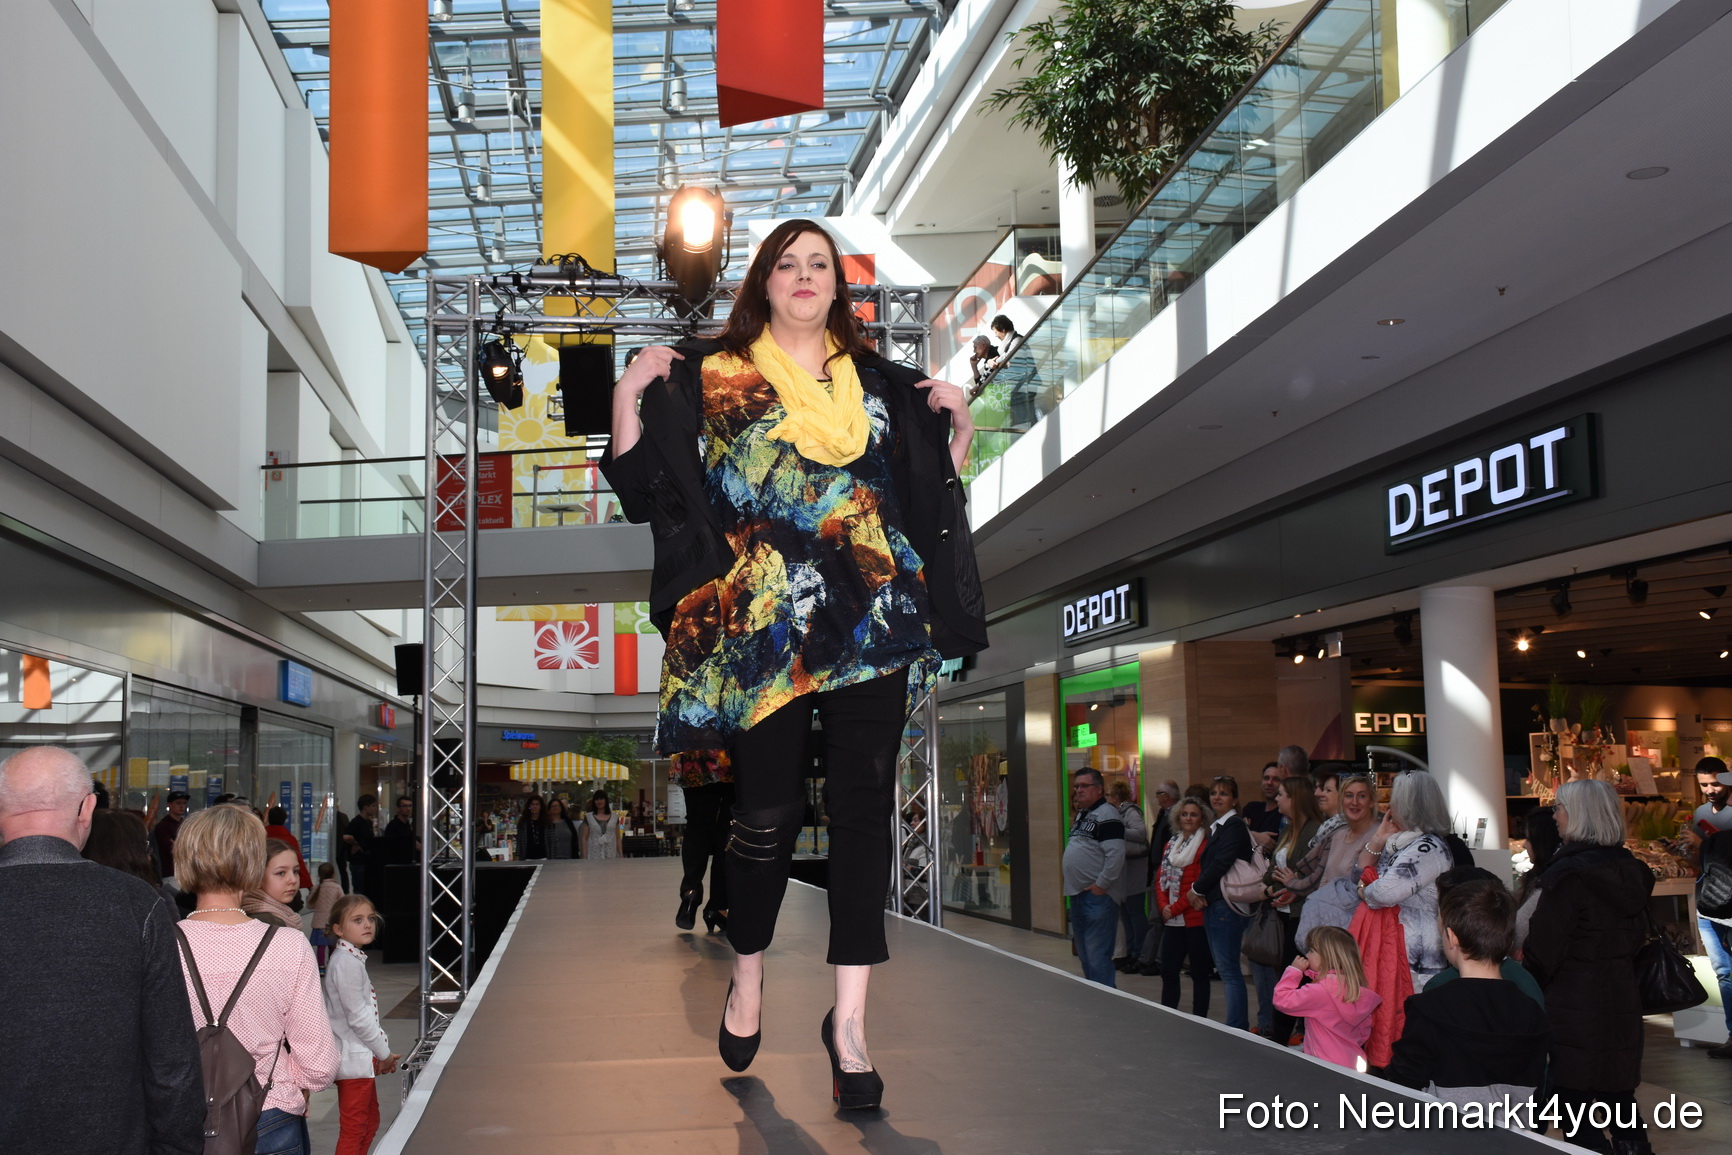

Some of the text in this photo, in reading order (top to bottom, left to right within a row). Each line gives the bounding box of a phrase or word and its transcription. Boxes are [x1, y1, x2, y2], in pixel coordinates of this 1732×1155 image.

[1388, 426, 1567, 537] DEPOT
[1063, 584, 1130, 637] DEPOT
[1354, 712, 1427, 733] EPOT
